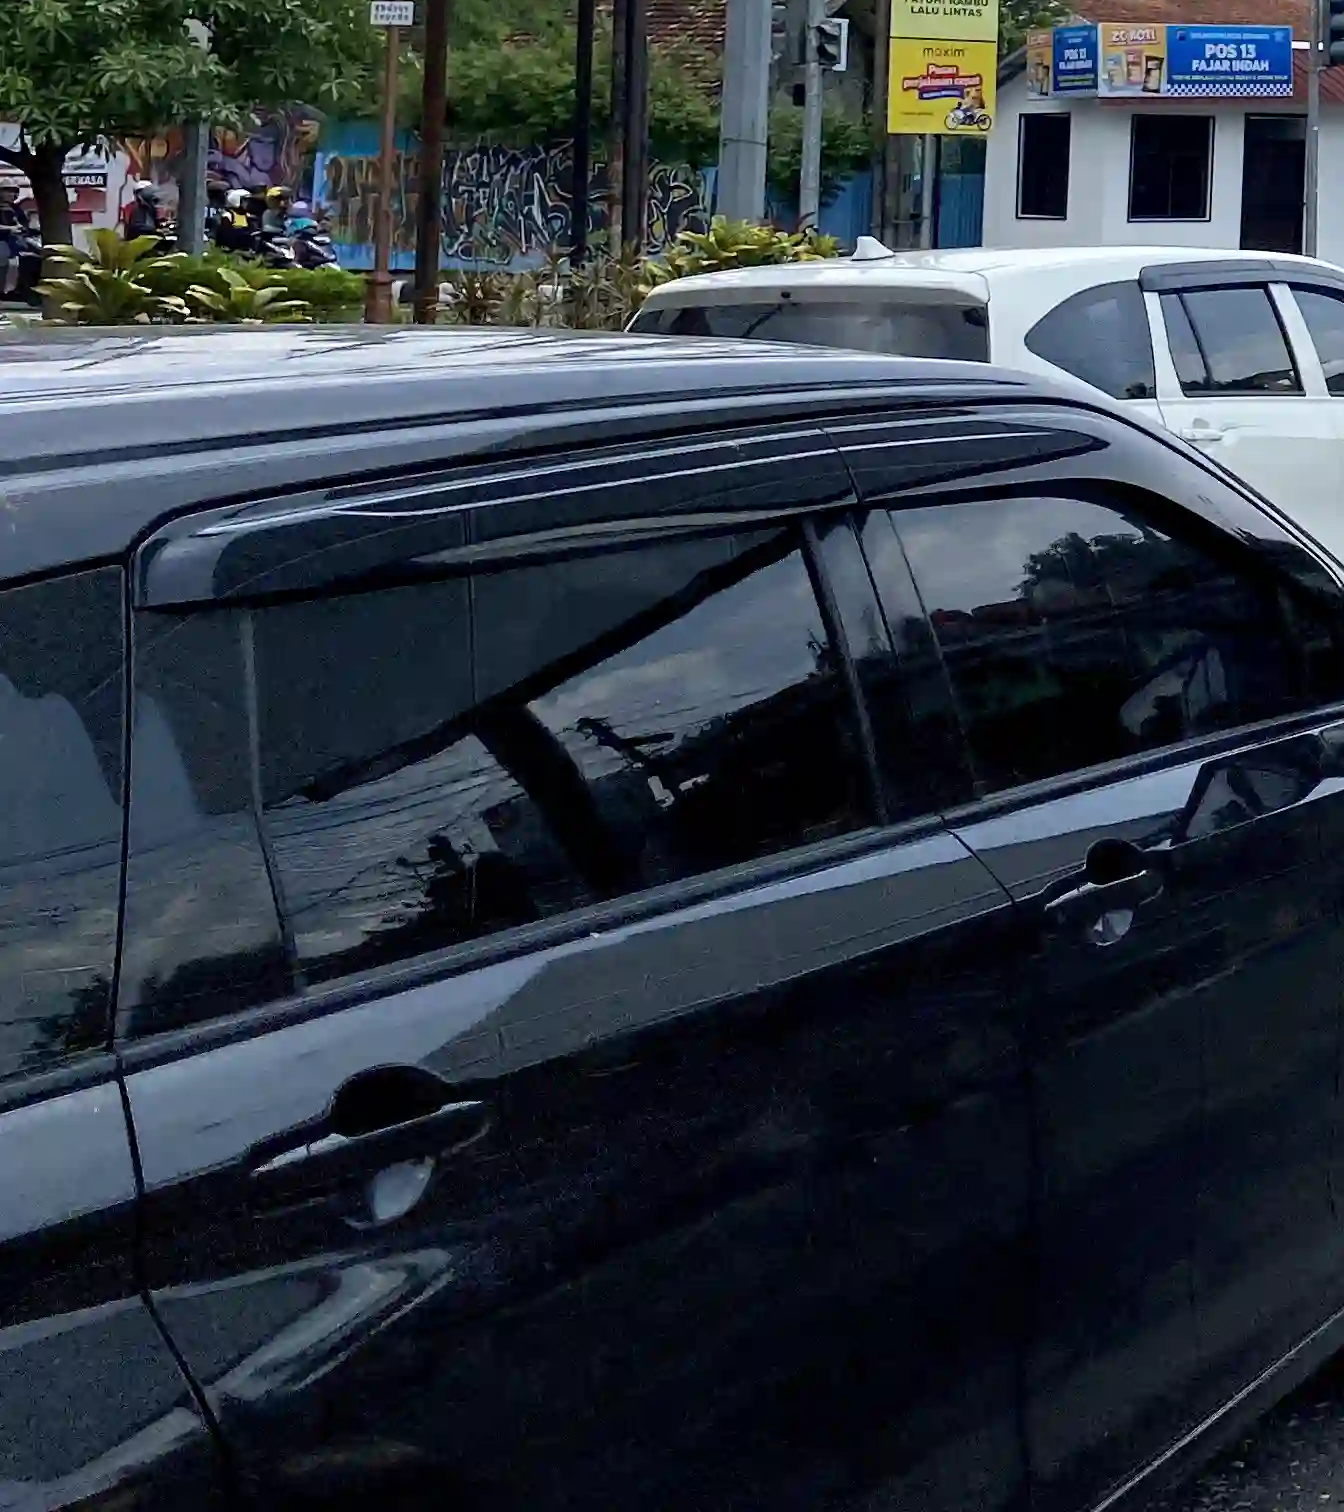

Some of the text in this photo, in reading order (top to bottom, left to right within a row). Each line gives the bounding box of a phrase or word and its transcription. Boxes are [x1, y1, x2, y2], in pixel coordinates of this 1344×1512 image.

[910, 5, 983, 17] LALU LINTAS
[923, 47, 966, 57] maxim
[1204, 43, 1257, 59] POS 13
[1192, 59, 1270, 72] FAJAR INDAH
